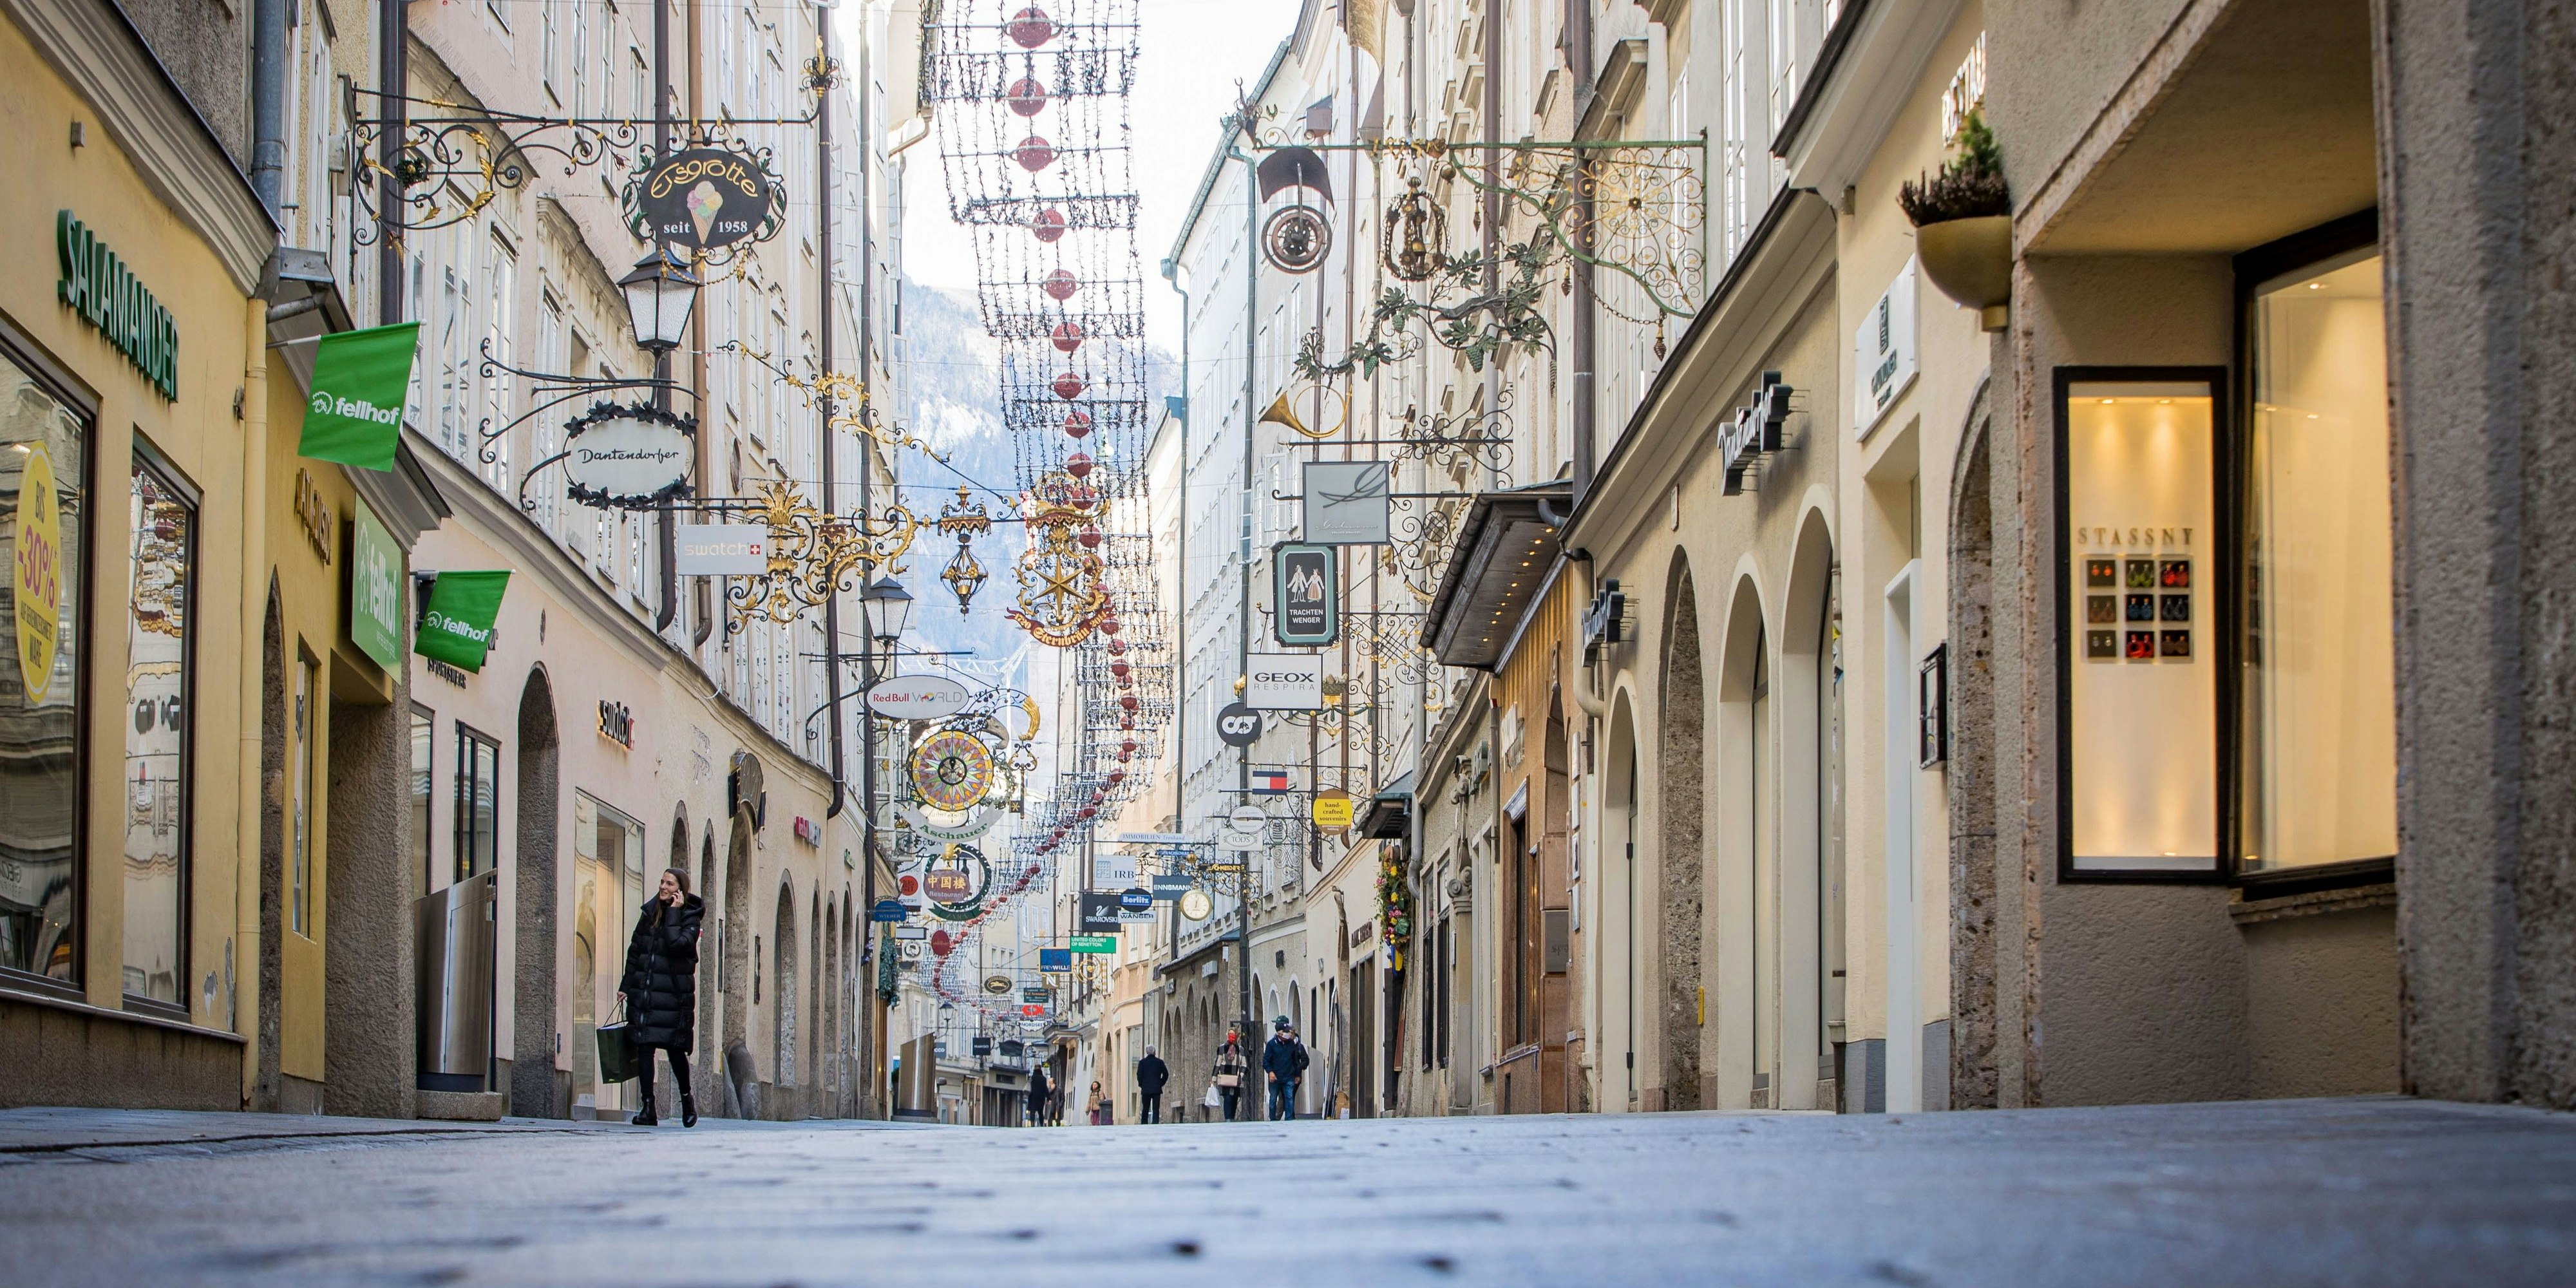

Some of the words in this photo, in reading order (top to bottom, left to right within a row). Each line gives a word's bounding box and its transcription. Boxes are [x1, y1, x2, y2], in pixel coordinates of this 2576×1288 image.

[651, 159, 758, 198] Eisgrotte
[663, 222, 690, 233] seit
[719, 221, 748, 233] 1958
[57, 209, 179, 404] SALAMANDER
[336, 397, 400, 425] fellhof
[578, 448, 679, 464] Dantendorfer
[35, 480, 45, 524] BIS
[2078, 527, 2193, 546] STASSNY
[684, 542, 748, 556] swatch
[369, 543, 397, 638] fellhof
[443, 617, 489, 643] fellhof
[1033, 627, 1090, 646] Sternbräu
[1254, 672, 1315, 683] GEOX
[873, 694, 891, 702] Red
[893, 693, 909, 702] Bull
[919, 823, 987, 840] Aschauer
[928, 875, 966, 890] 中国楼
[1114, 870, 1135, 878] IRB
